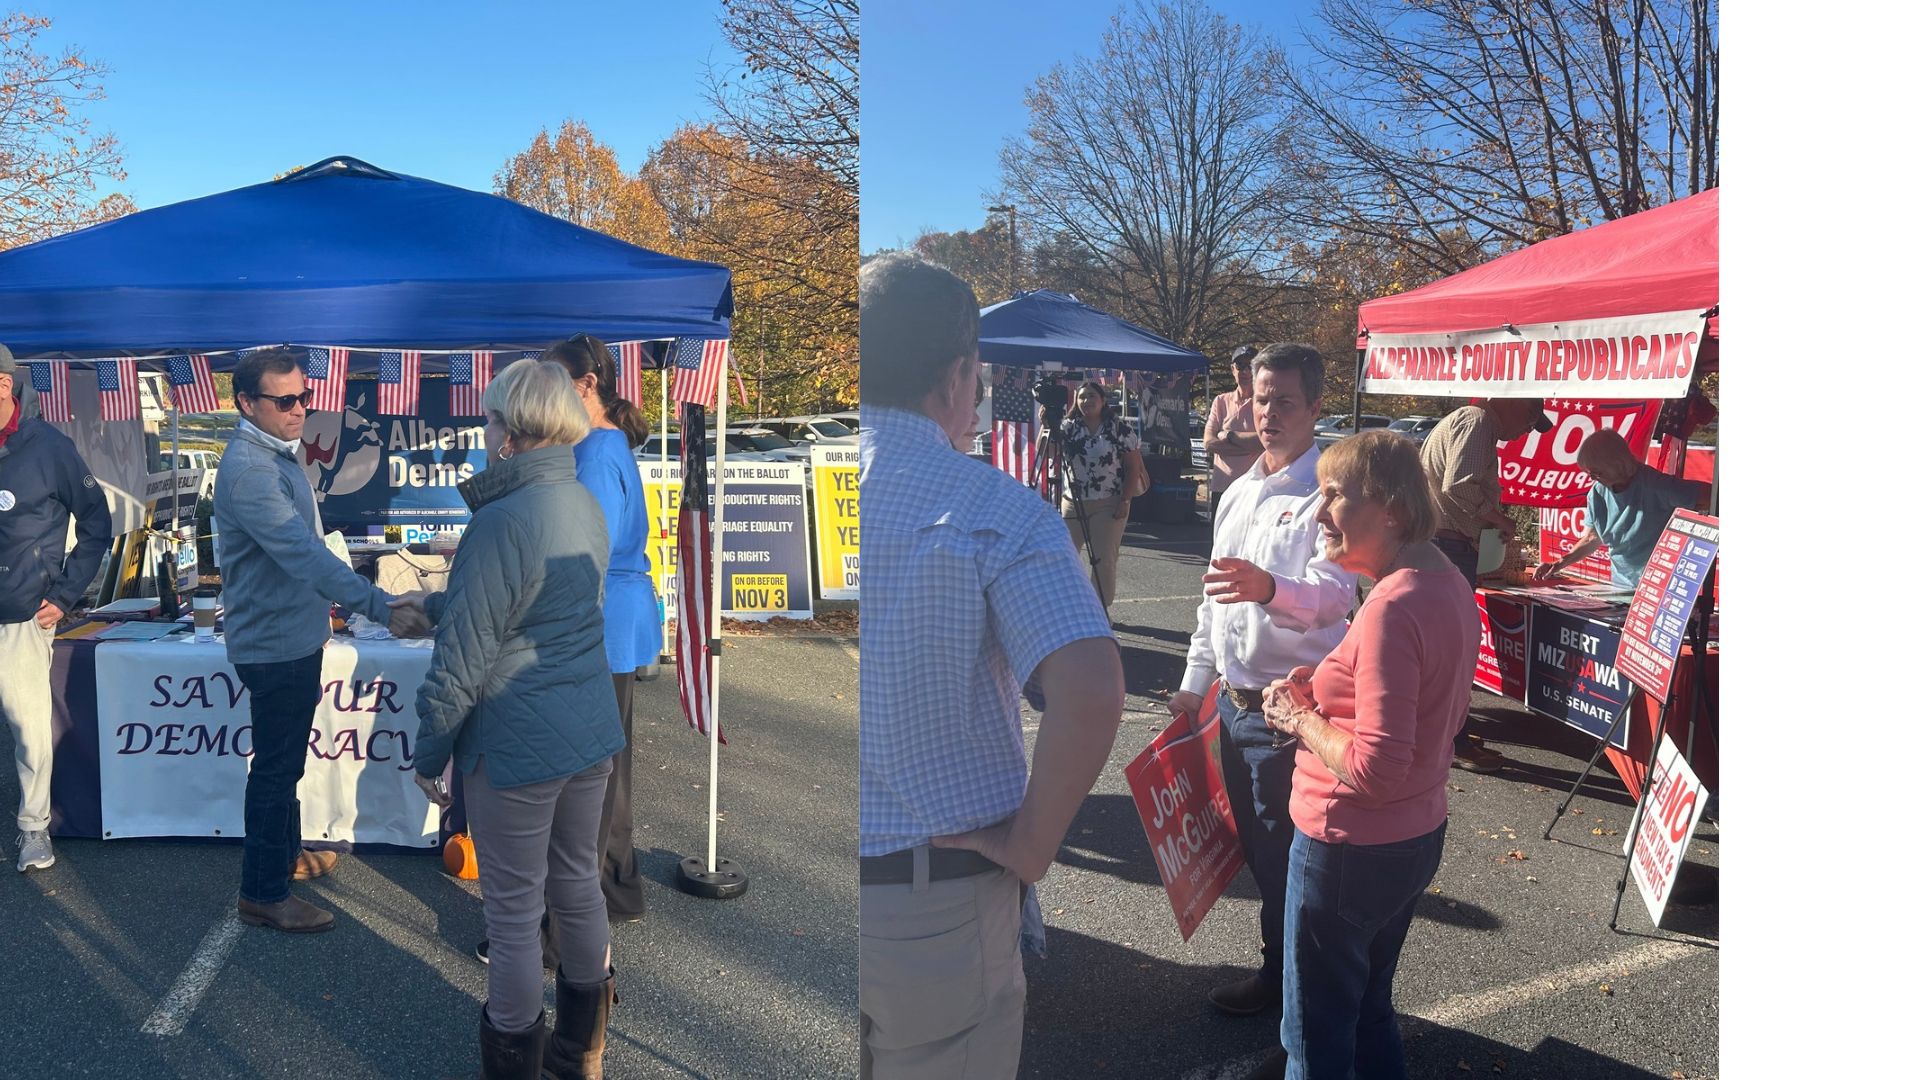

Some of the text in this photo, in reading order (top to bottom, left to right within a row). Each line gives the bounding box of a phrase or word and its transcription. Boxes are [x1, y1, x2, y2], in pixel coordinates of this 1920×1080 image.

[1366, 331, 1698, 381] ALBEMARLE COUNTY REPUBLICANS
[388, 420, 486, 451] Albem
[388, 456, 474, 487] Dems
[723, 469, 733, 478] ON
[737, 469, 754, 479] THE
[757, 469, 790, 479] BALLOT
[825, 452, 859, 462] OUR RIG
[769, 495, 801, 506] RIGHTS
[750, 521, 794, 533] EQUALITY
[737, 551, 771, 562] RIGHTS
[735, 577, 784, 586] ON OR BEFORE
[735, 589, 786, 608] NOV 3
[1560, 626, 1600, 656] BERT
[1538, 642, 1620, 691] MIZUSAWA
[150, 672, 251, 709] SAV
[1543, 685, 1613, 724] U.S. SENATE
[116, 722, 417, 772] DEMORACY
[1150, 768, 1193, 829] JOHN
[1659, 771, 1696, 844] NO
[1643, 812, 1674, 876] NEW TAX &
[1189, 839, 1224, 886] FOR VIRGINIA
[1634, 831, 1666, 902] ENDMENTS
